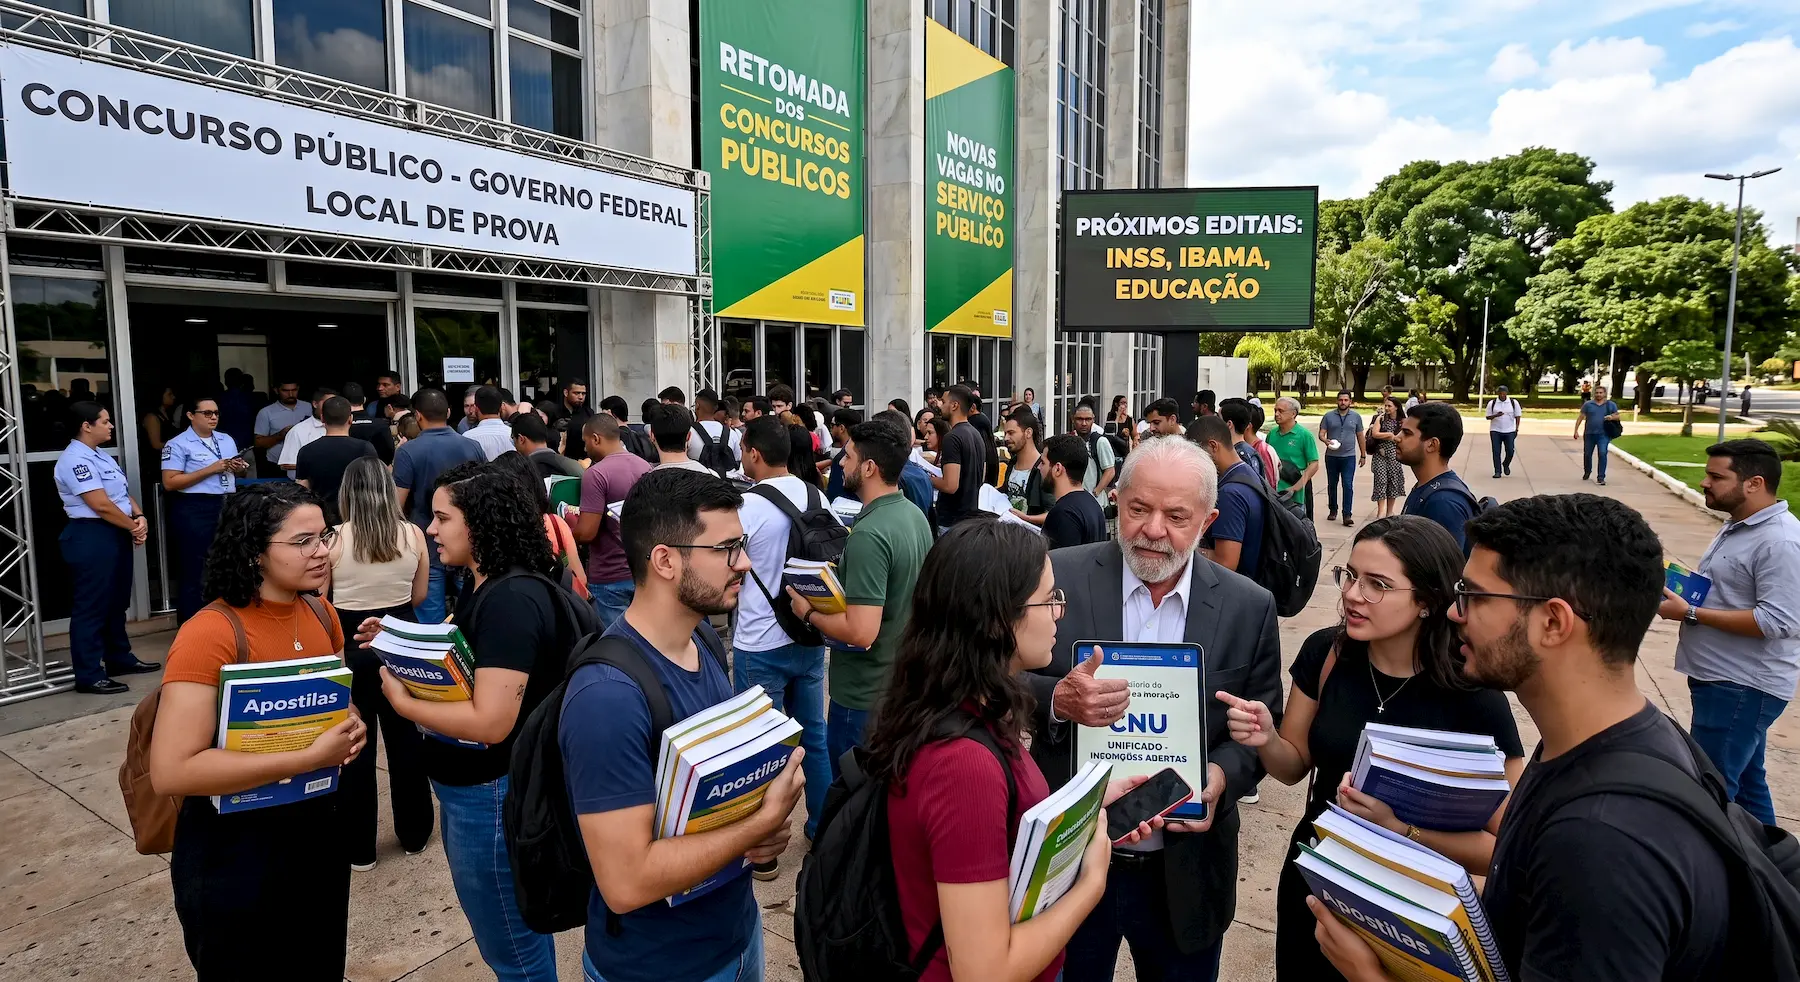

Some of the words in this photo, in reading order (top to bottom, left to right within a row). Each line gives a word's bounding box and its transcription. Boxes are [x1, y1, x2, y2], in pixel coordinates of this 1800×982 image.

[719, 41, 850, 118] RETOMADA
[775, 96, 804, 121] DOS
[20, 82, 283, 156] CONCURSO
[294, 131, 443, 184] PÚBLICO
[469, 167, 593, 211] GOVERNO
[600, 192, 688, 228] FEDERAL
[720, 103, 850, 164] CONCURSOS
[947, 130, 996, 169] NOVAS
[721, 136, 850, 199] PÚBLICOS
[936, 152, 983, 189] VAGAS
[986, 174, 1005, 195] NO
[306, 186, 418, 228] LOCAL
[427, 205, 465, 233] DE
[472, 211, 560, 246] PROVA
[936, 180, 1004, 224] SERVIÇO
[936, 209, 1004, 249] PÚBLICO
[1076, 213, 1200, 236] PRÓXIMOS
[1205, 214, 1303, 235] EDITAIS:
[1106, 247, 1172, 271] INSS,
[1179, 246, 1271, 270] IBAMA,
[1115, 272, 1260, 304] EDUCAÇÃO
[242, 692, 338, 716] Apostilas
[1107, 741, 1163, 751] UNIFICADO
[706, 753, 788, 801] Apostilas
[1321, 888, 1431, 956] Apostilas
